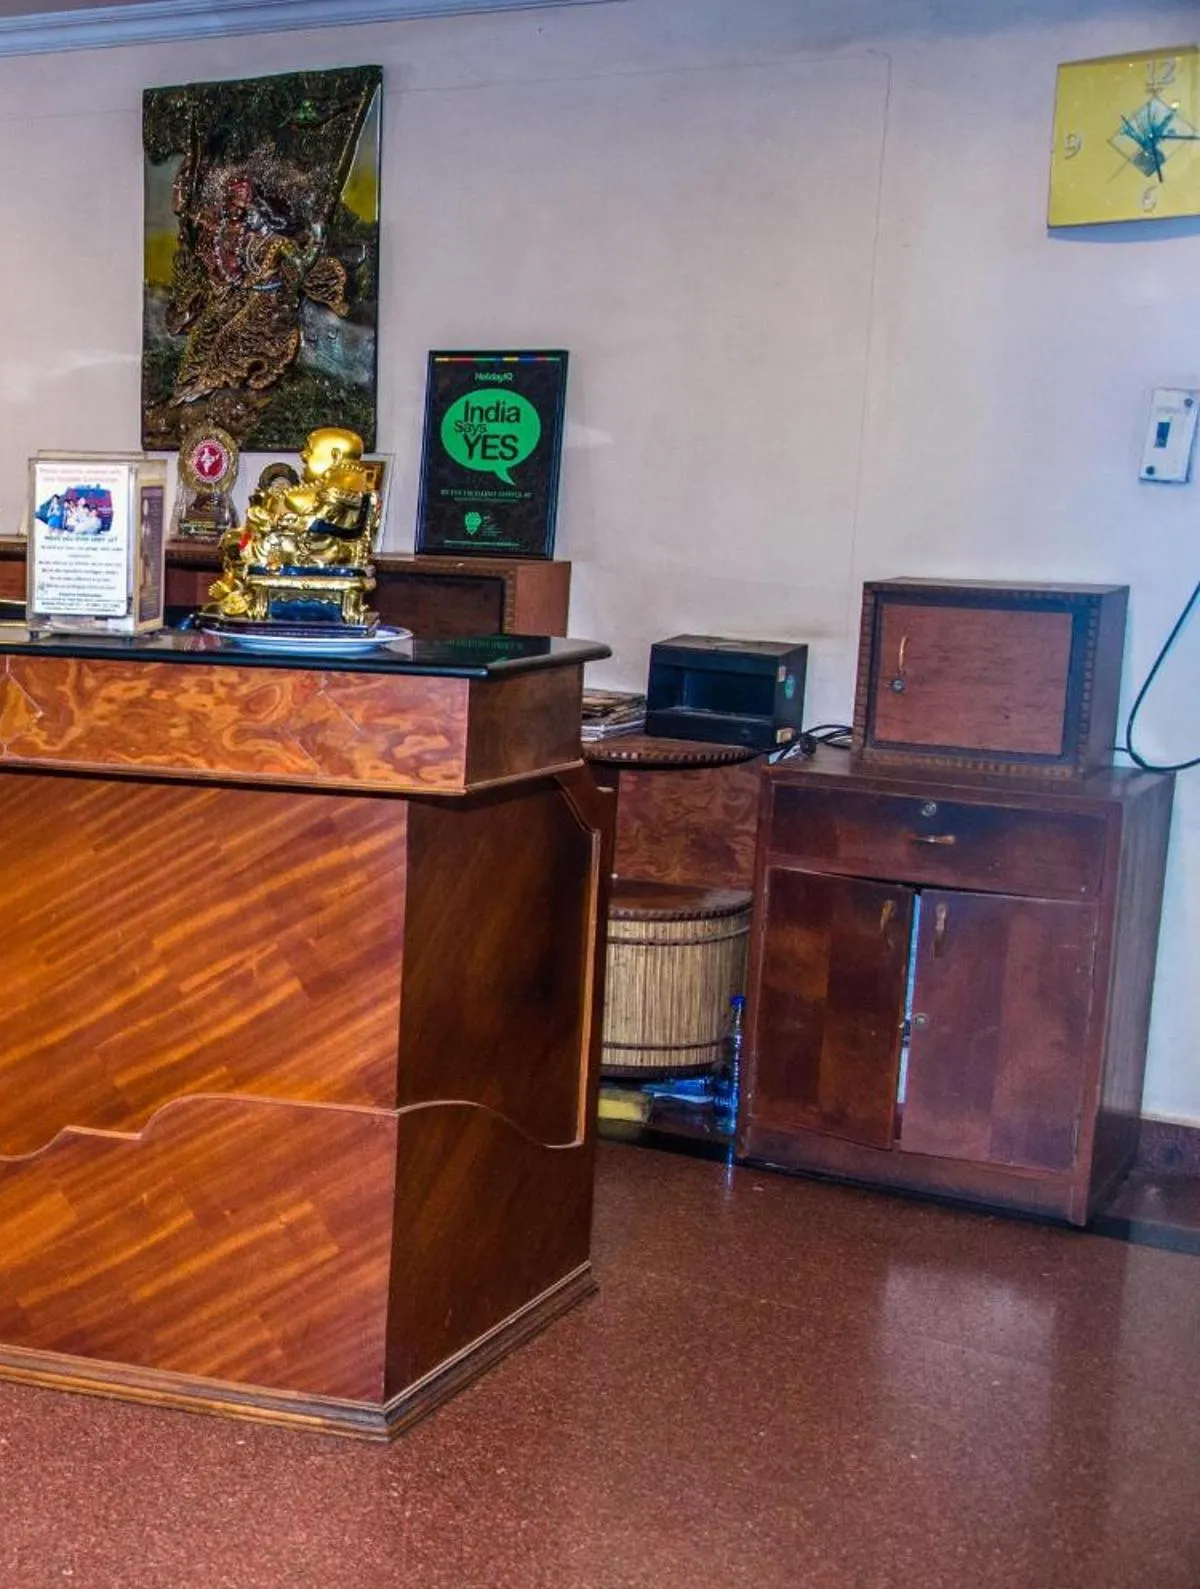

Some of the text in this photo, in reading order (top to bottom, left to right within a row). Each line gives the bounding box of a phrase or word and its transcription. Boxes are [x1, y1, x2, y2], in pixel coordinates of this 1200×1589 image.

[1146, 59, 1176, 85] 12
[1065, 133, 1083, 160] 9
[1142, 186, 1157, 213] 6
[463, 400, 521, 423] India
[454, 420, 488, 436] Says
[463, 434, 520, 461] YES
